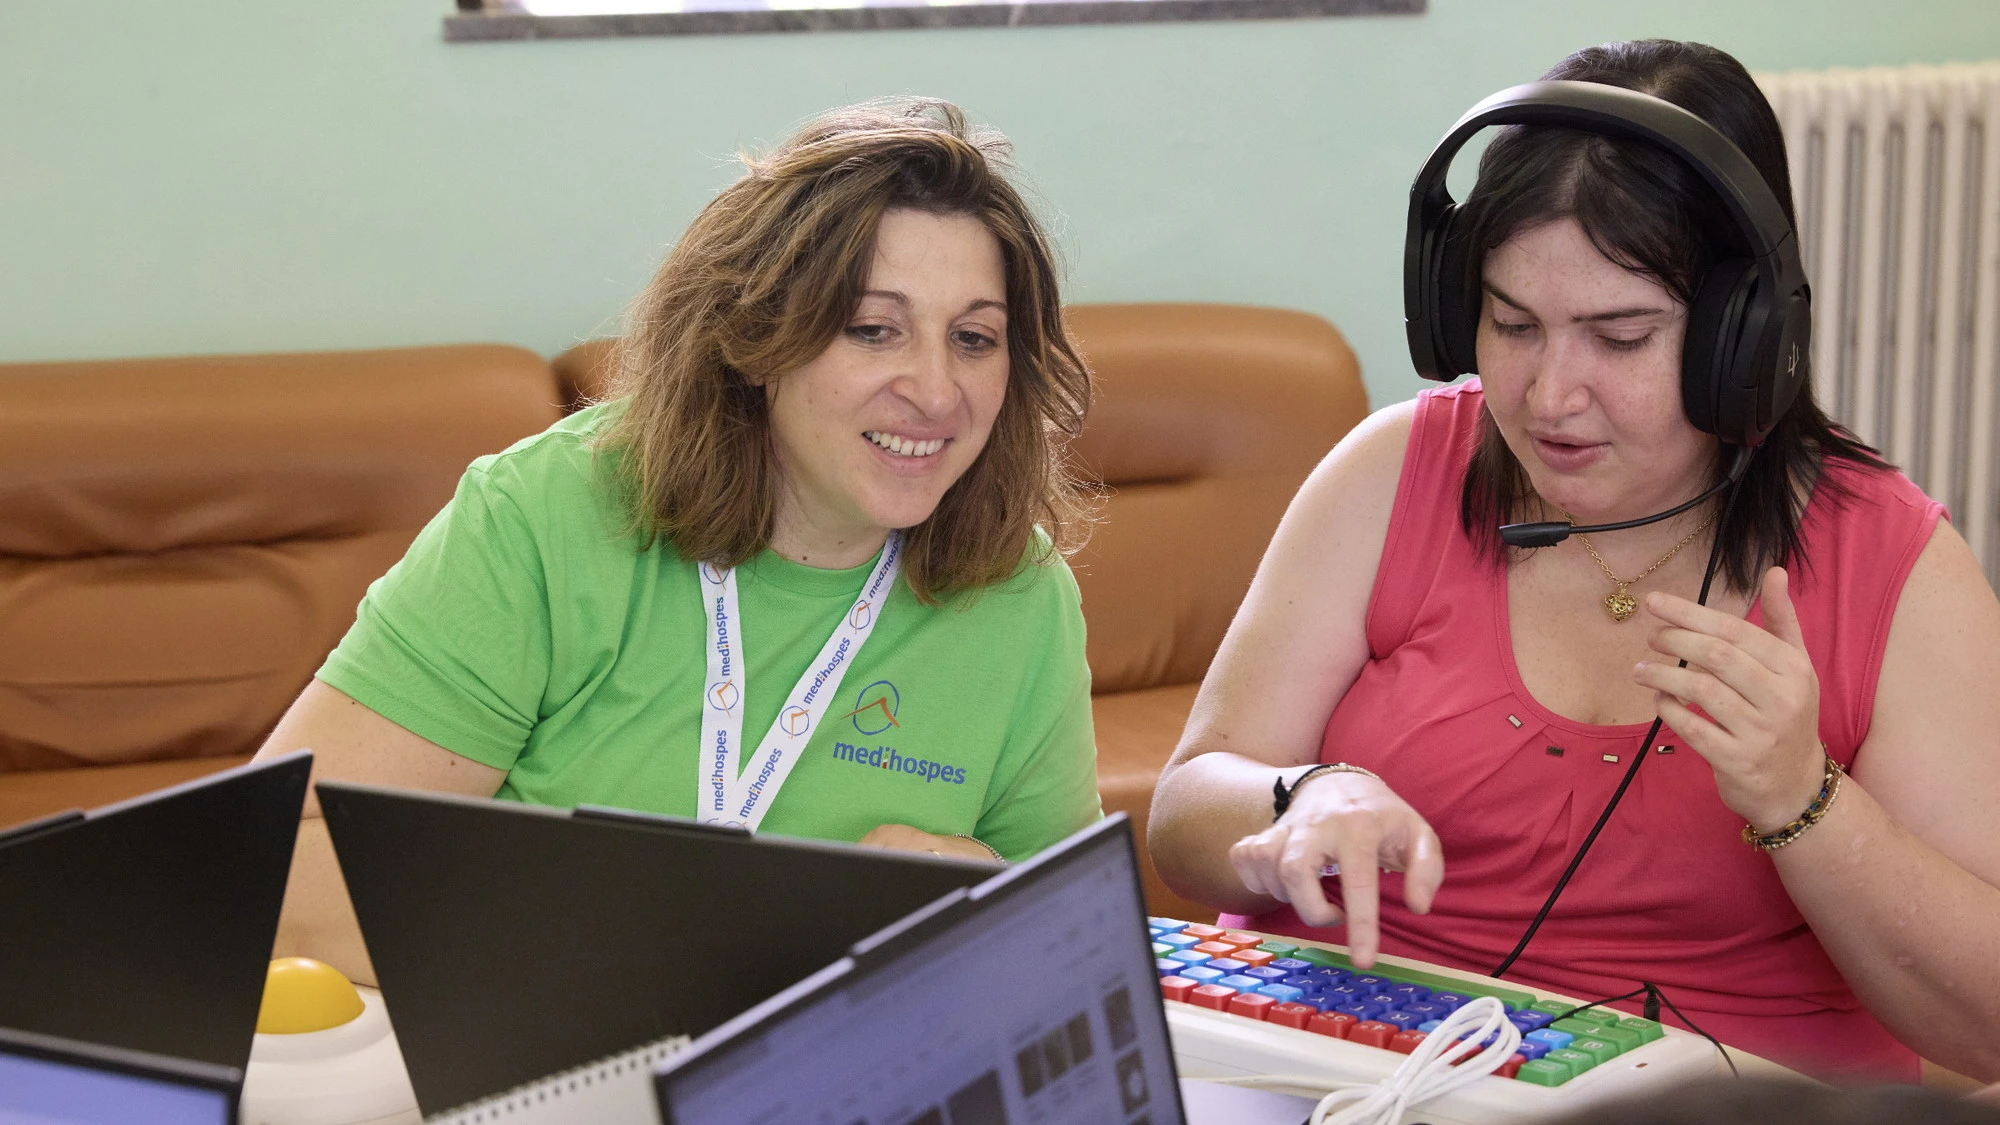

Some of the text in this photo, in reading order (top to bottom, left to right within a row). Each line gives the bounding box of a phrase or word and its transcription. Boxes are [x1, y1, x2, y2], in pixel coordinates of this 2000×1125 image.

[715, 596, 731, 677] medihospes
[803, 637, 851, 705] medihospes
[711, 729, 729, 811] medihospes
[739, 748, 783, 818] medihospes
[832, 741, 967, 785] medihospes
[1391, 1013, 1410, 1021] R
